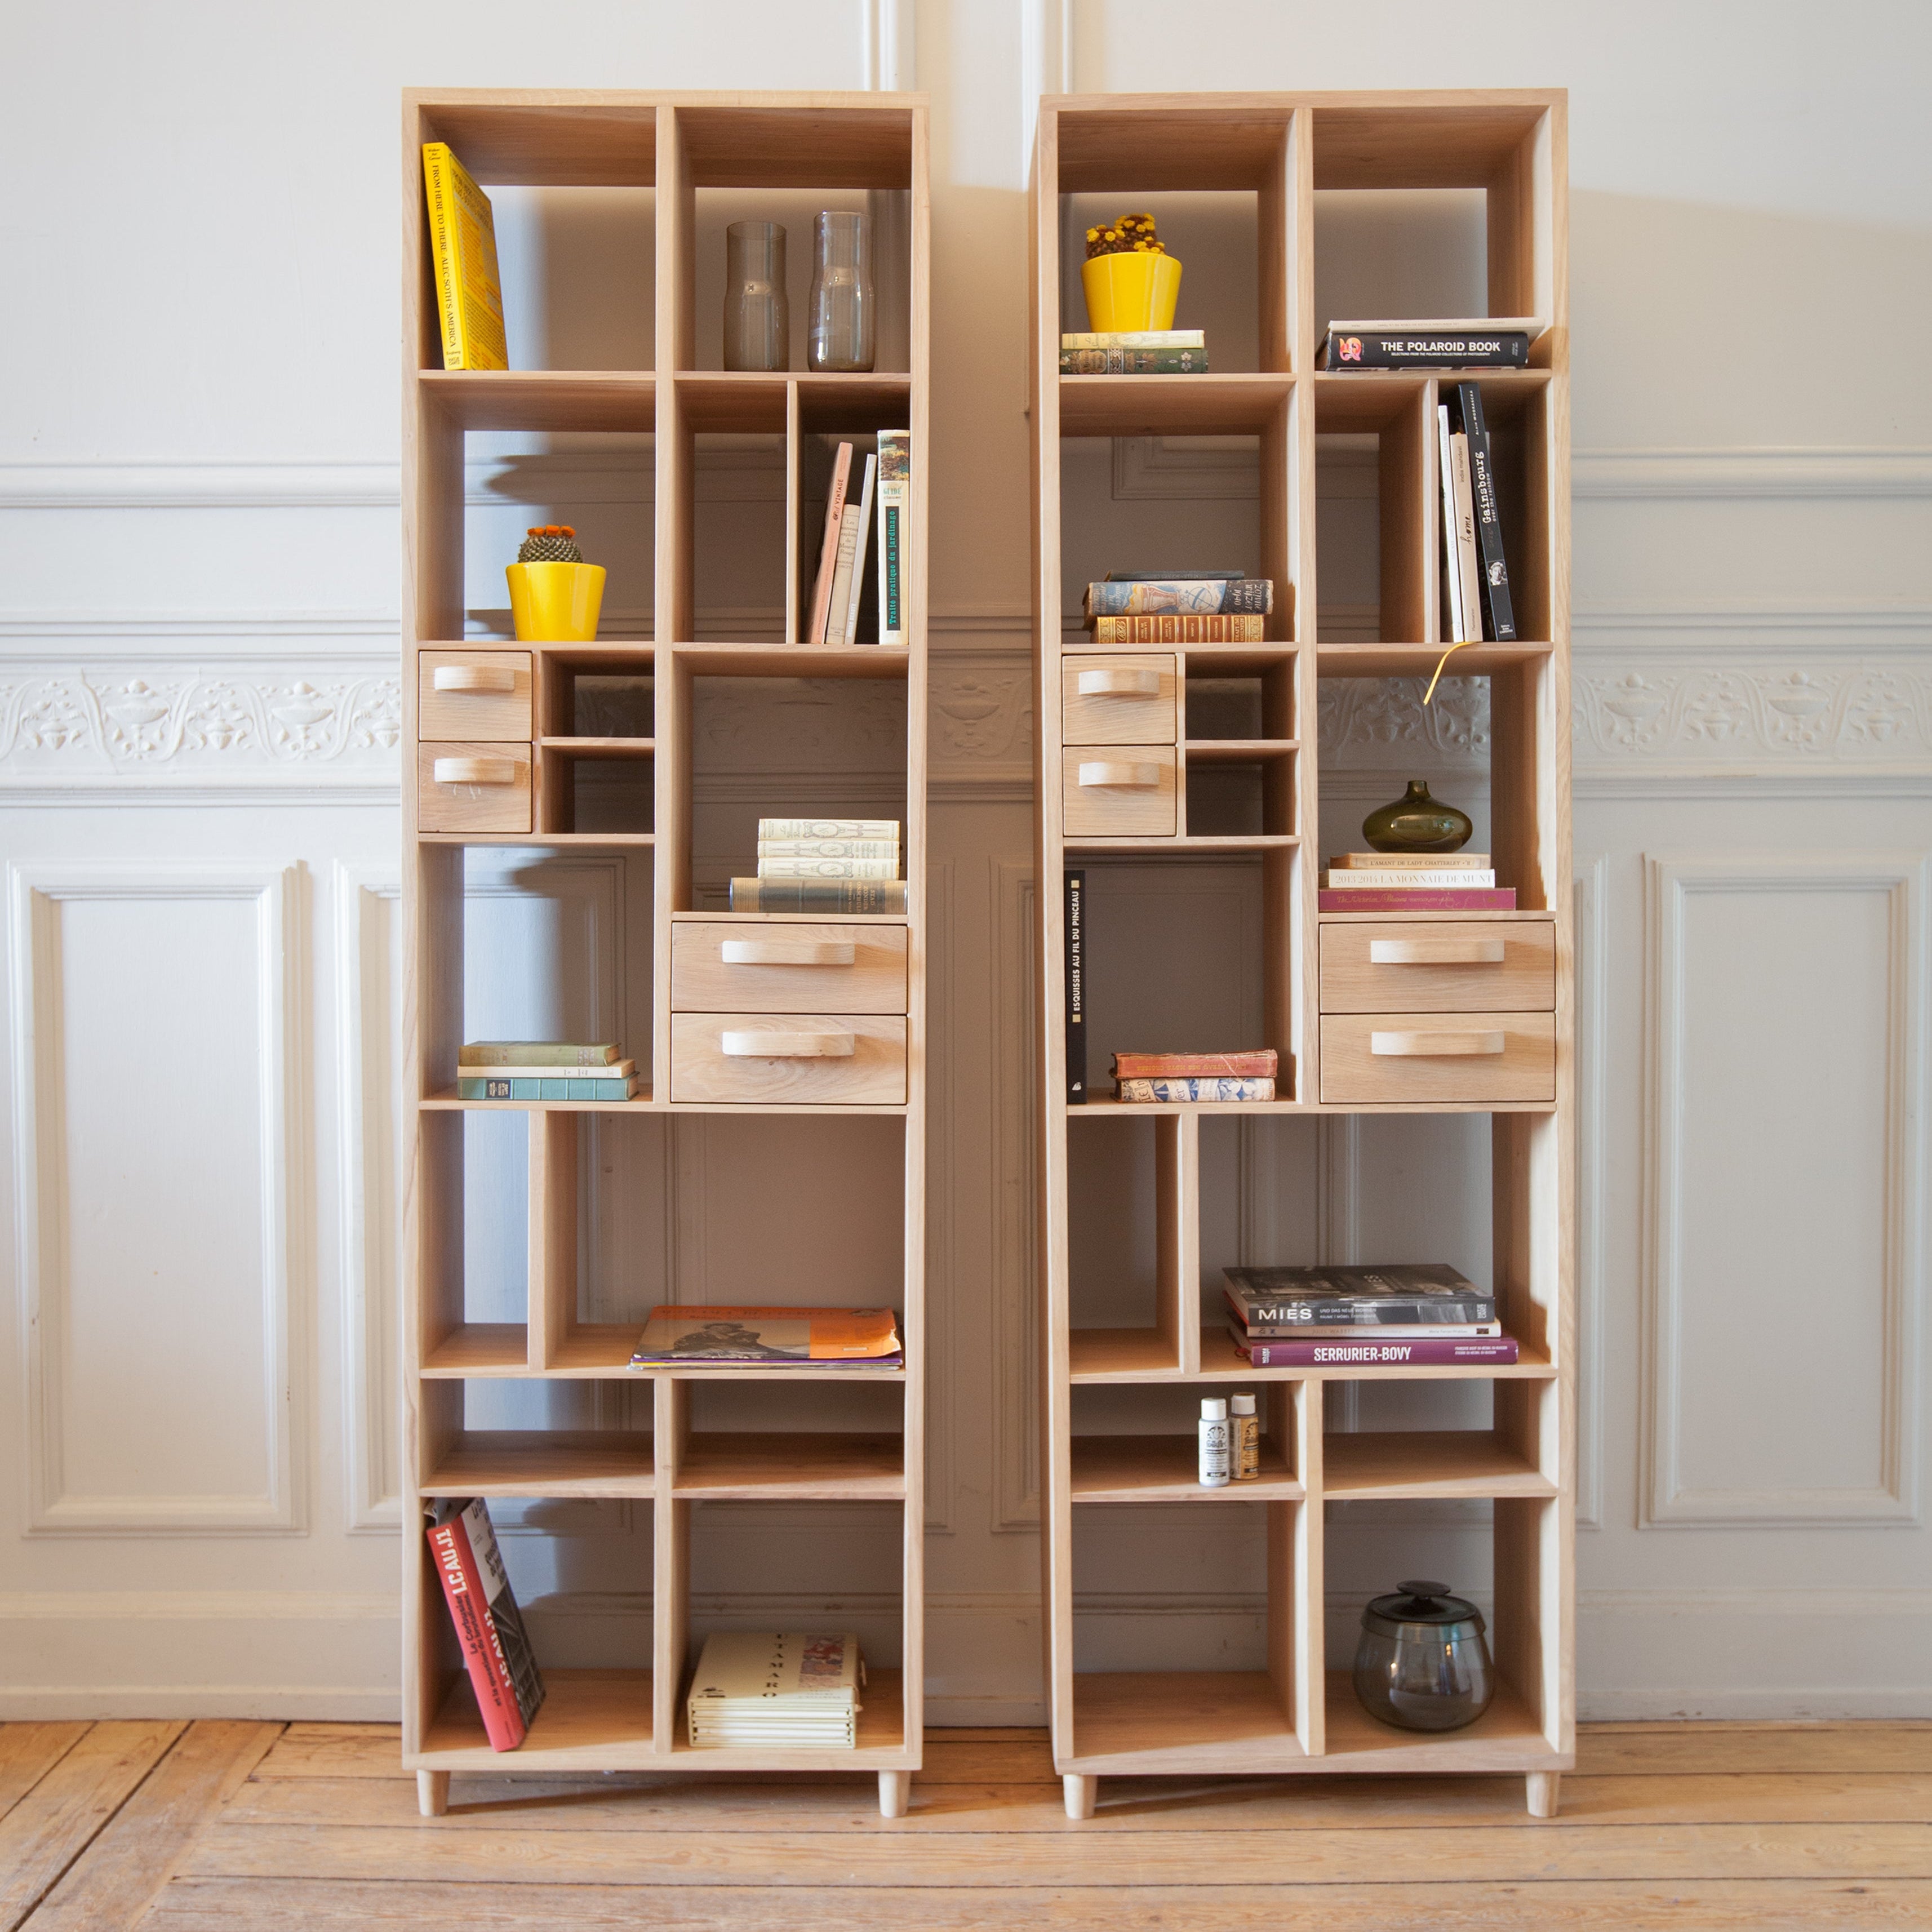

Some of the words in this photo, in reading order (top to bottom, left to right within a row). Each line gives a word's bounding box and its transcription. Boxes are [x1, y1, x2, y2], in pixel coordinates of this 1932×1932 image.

[432, 165, 441, 189] FROM
[434, 189, 443, 212] HERE
[437, 212, 445, 225] TO
[441, 256, 450, 278] ALEC
[446, 310, 456, 348] AMERICA
[1380, 341, 1406, 352] THE
[1407, 341, 1465, 352] POLAROID
[1468, 341, 1501, 352] BOOK
[834, 478, 844, 505] VINTAGE
[1475, 451, 1492, 524] Gainsbourg
[1460, 513, 1472, 545] home
[889, 551, 896, 561] du
[889, 563, 898, 597] pratique
[1233, 589, 1242, 606] 1940
[1335, 875, 1356, 884] 2013
[1358, 875, 1378, 884] 2014
[1380, 875, 1393, 883] LA
[1396, 875, 1444, 883] MONNAIE
[1072, 929, 1080, 940] DU
[1072, 952, 1080, 967] AU
[1258, 1308, 1312, 1320] MIES
[1314, 1347, 1411, 1362] SERRURIER-BOVY
[441, 1549, 461, 1571] AU
[448, 1571, 467, 1595] LC
[456, 1594, 474, 1641] Corbusier
[469, 1644, 478, 1655] Le
